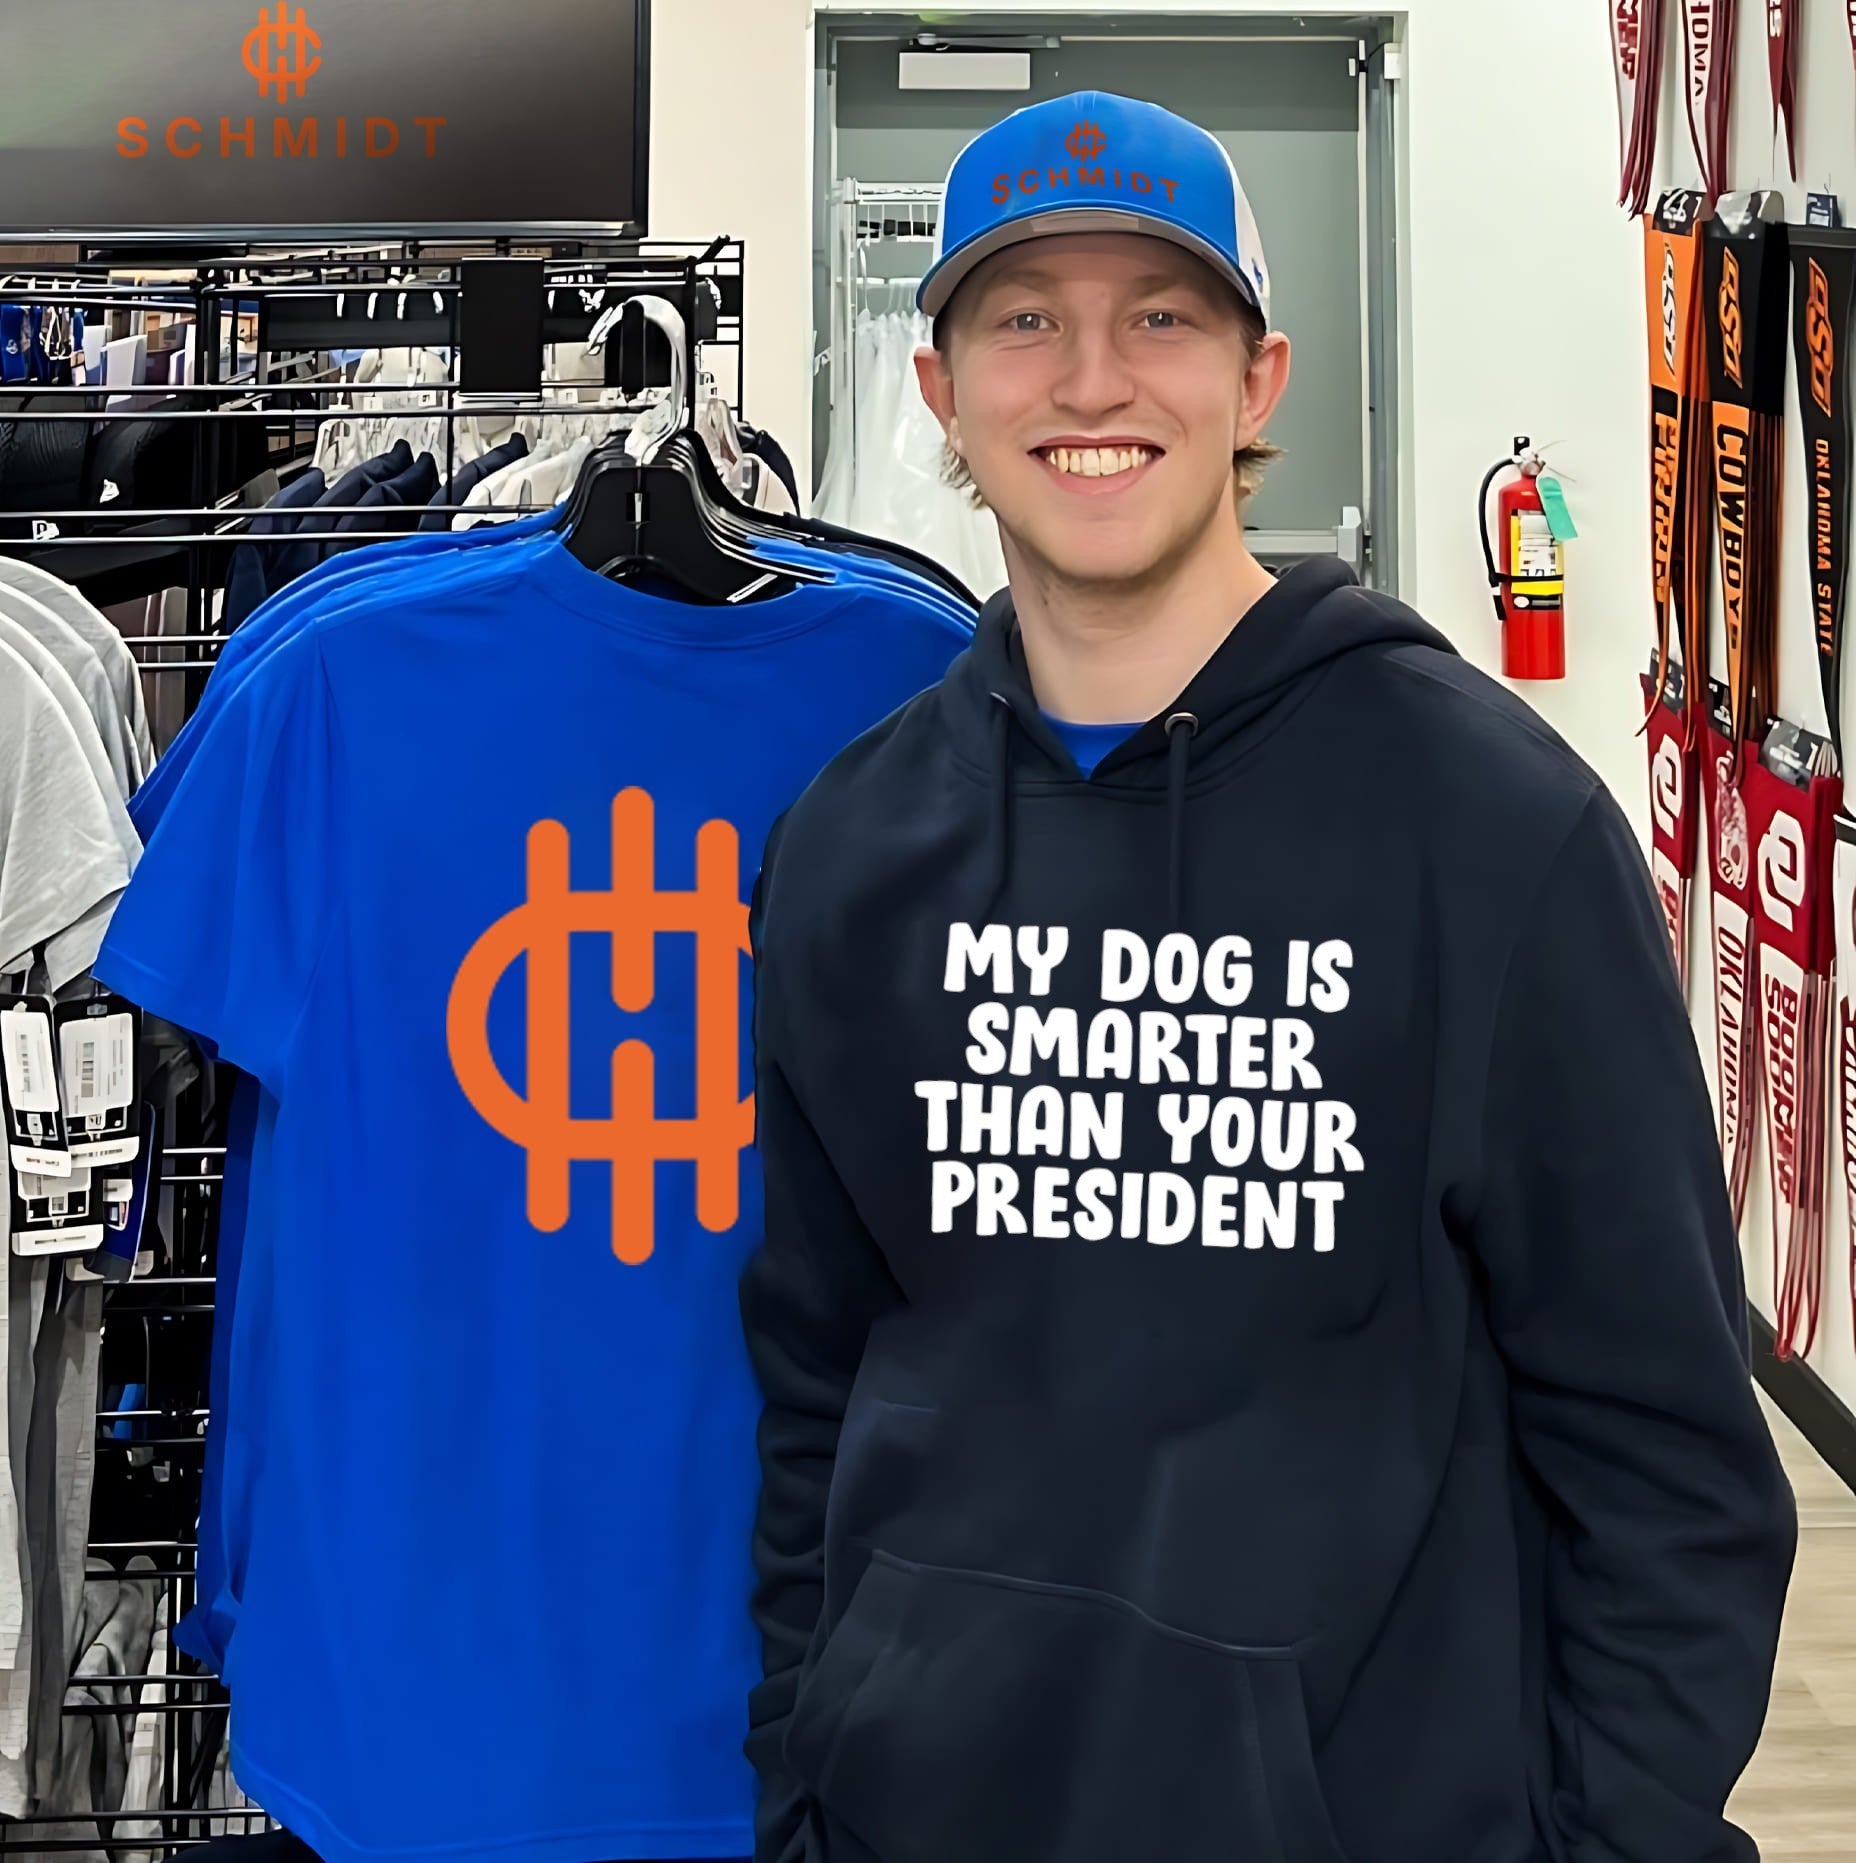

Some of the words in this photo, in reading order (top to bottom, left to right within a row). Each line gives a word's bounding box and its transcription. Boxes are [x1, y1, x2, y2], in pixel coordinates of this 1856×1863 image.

[115, 116, 449, 159] SCHMIDT
[992, 166, 1179, 204] SCHMIDT
[1815, 438, 1832, 570] OKLAHOMA
[944, 922, 1068, 996] MY
[1101, 929, 1253, 1006] DOG
[1287, 940, 1353, 1013] IS
[966, 1002, 1322, 1091] SMARTER
[1718, 926, 1745, 1143] OKLAHOMA
[915, 1081, 1123, 1160] THAN
[1158, 1094, 1364, 1173] YOUR
[932, 1161, 1344, 1252] PRESIDENT
